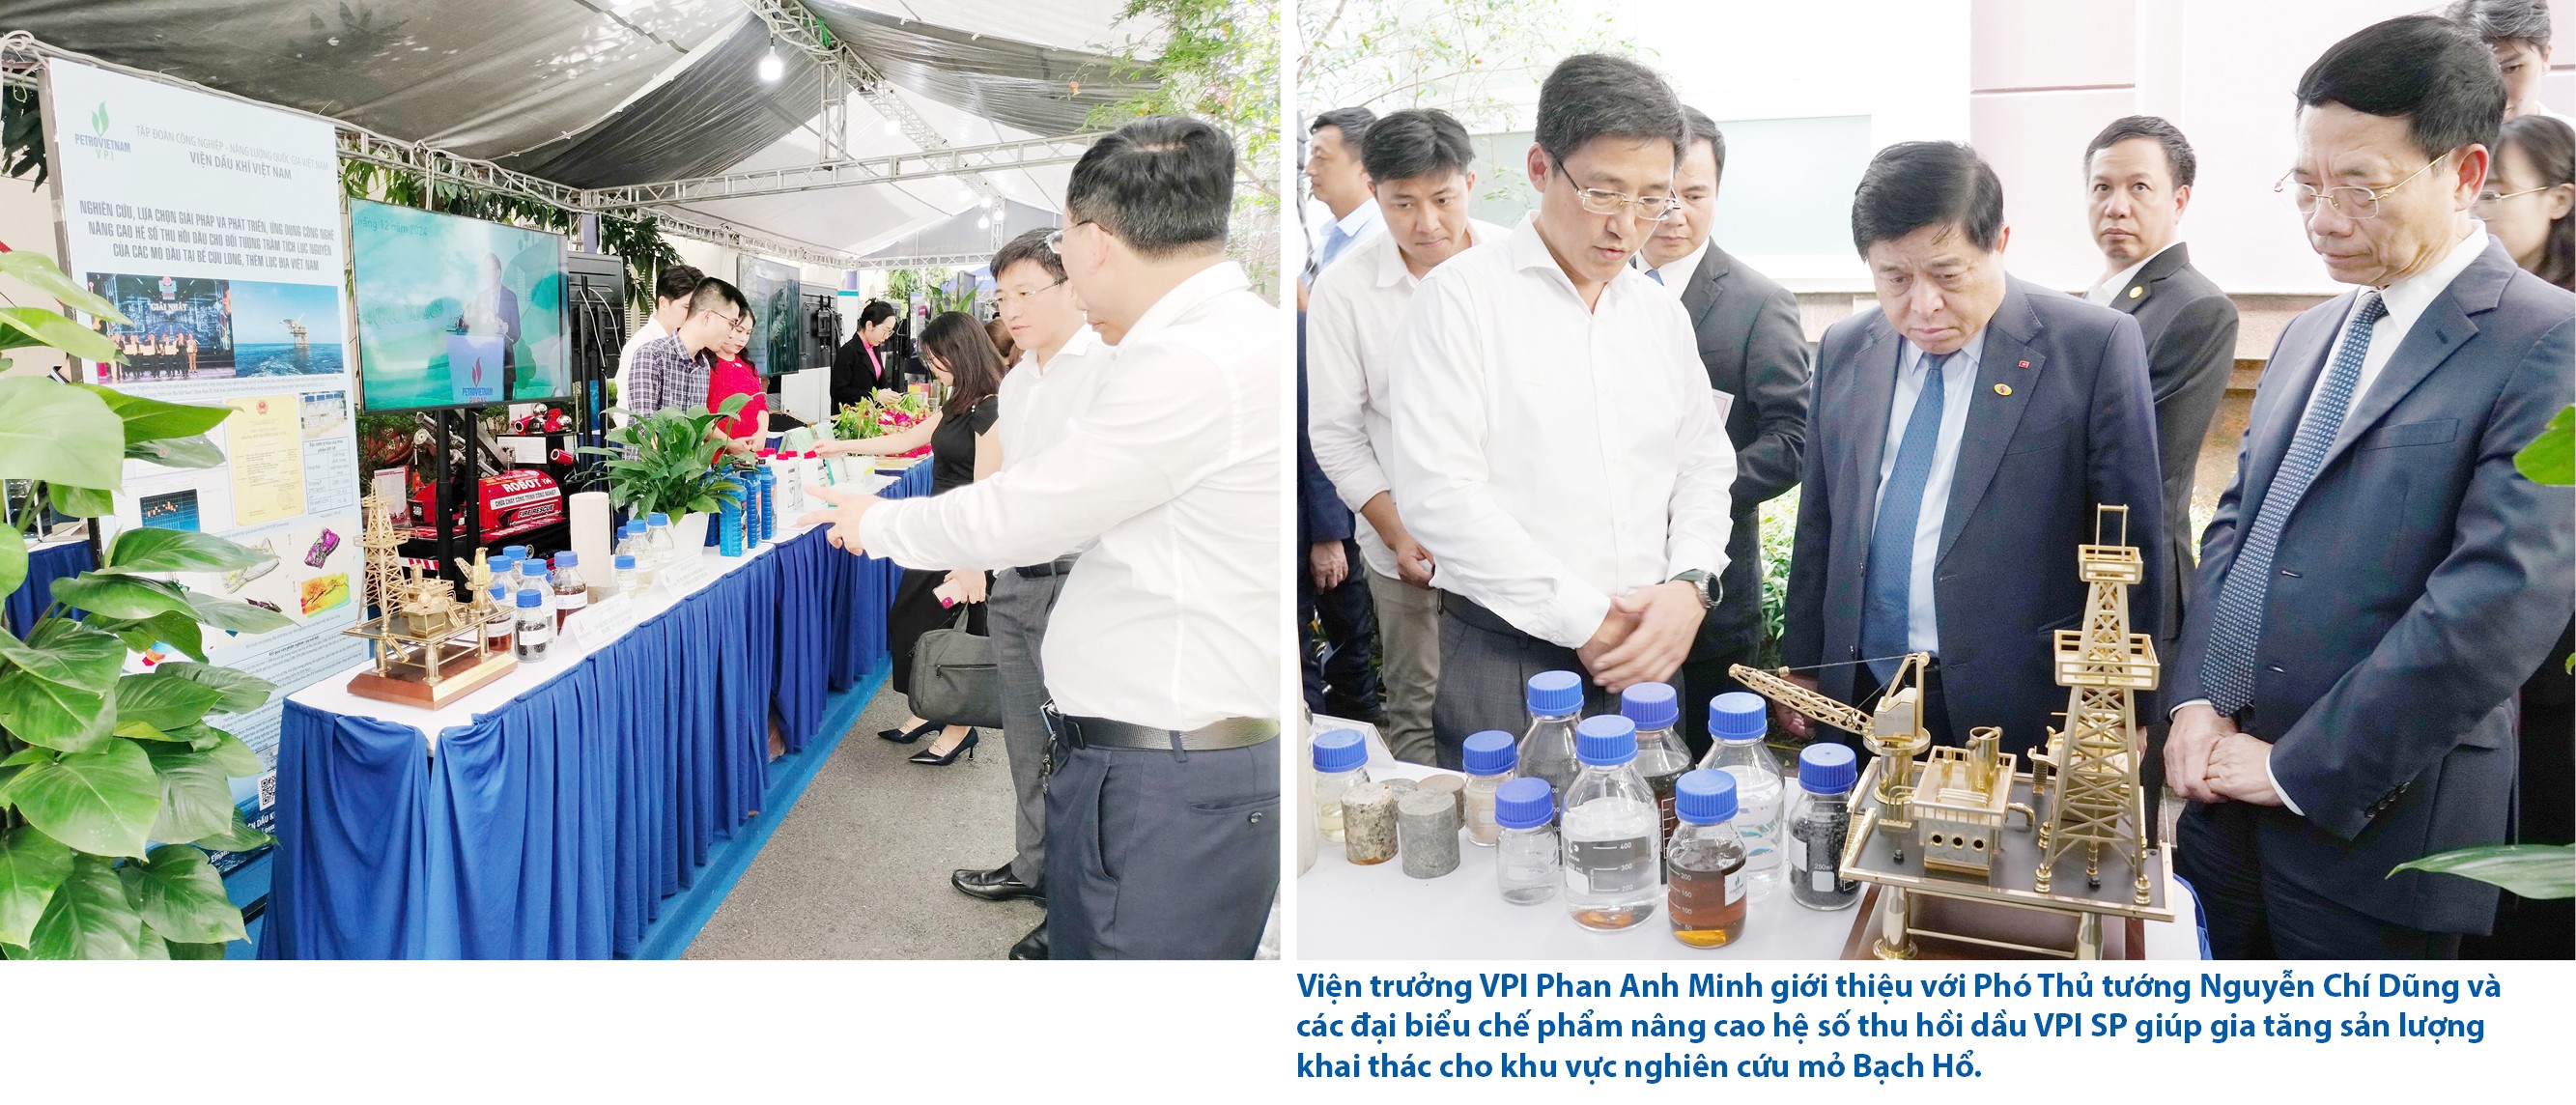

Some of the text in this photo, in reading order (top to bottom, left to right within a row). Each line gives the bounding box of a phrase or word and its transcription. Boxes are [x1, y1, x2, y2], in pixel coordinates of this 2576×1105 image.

[74, 133, 131, 153] PETROVIETNAM
[189, 151, 293, 181] VIỆN DẦU KHÍ VIỆT NAM
[462, 387, 494, 396] PETROVIETNAM
[501, 478, 542, 493] ROBOT
[518, 503, 554, 519] FIRE RESCUE
[1620, 841, 1632, 850] 400
[1621, 863, 1633, 871] 300
[1622, 884, 1633, 892] 200
